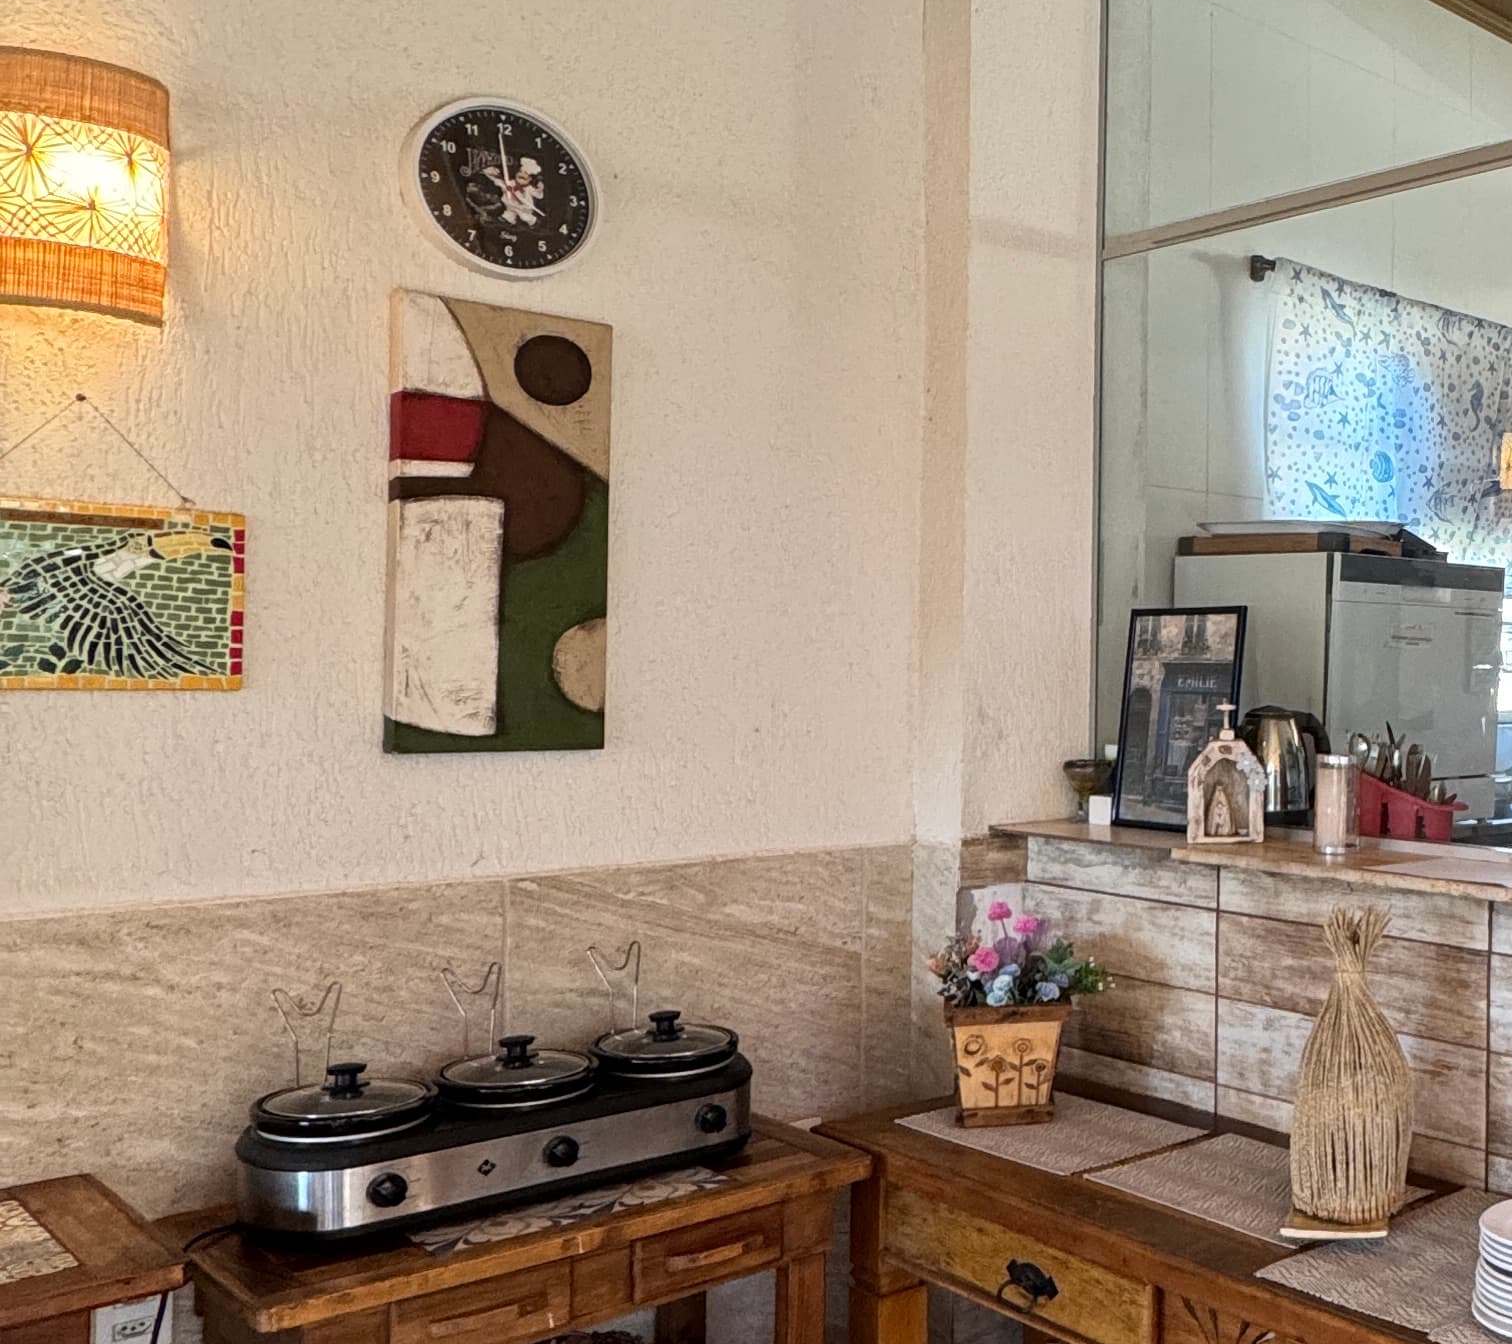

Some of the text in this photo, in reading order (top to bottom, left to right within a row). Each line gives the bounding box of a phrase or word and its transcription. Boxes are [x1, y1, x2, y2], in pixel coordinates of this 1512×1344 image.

[465, 124, 478, 136] 11
[496, 123, 513, 136] 12
[439, 140, 456, 154] 10
[535, 137, 543, 149] 1
[558, 163, 567, 175] 2
[430, 171, 440, 183] 9
[569, 195, 578, 207] 3
[443, 204, 452, 216] 8
[468, 230, 477, 241] 7
[559, 224, 568, 235] 4
[504, 246, 513, 257] 6
[538, 240, 547, 252] 5
